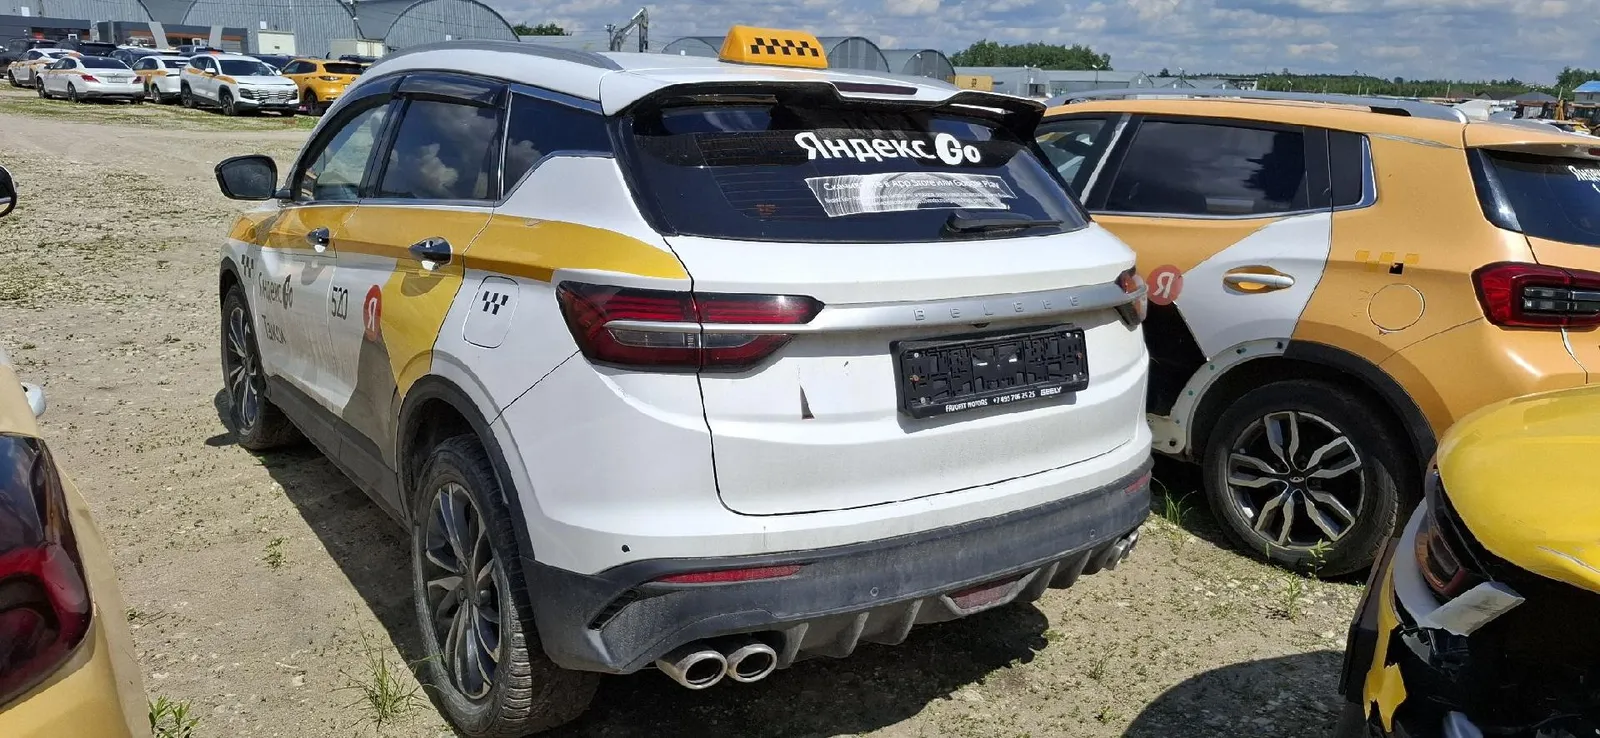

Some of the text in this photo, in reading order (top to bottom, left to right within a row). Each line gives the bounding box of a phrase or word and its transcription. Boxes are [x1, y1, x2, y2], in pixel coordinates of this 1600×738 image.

[794, 131, 982, 165] Яндекс Go
[890, 179, 912, 189] App
[912, 179, 938, 188] Store
[1152, 271, 1175, 299] Я
[331, 286, 349, 321] 520
[367, 297, 378, 332] Я
[261, 314, 288, 345] Такси
[945, 403, 967, 413] FAVORIT
[967, 398, 988, 409] MOTORS
[1040, 386, 1062, 396] GEELY
